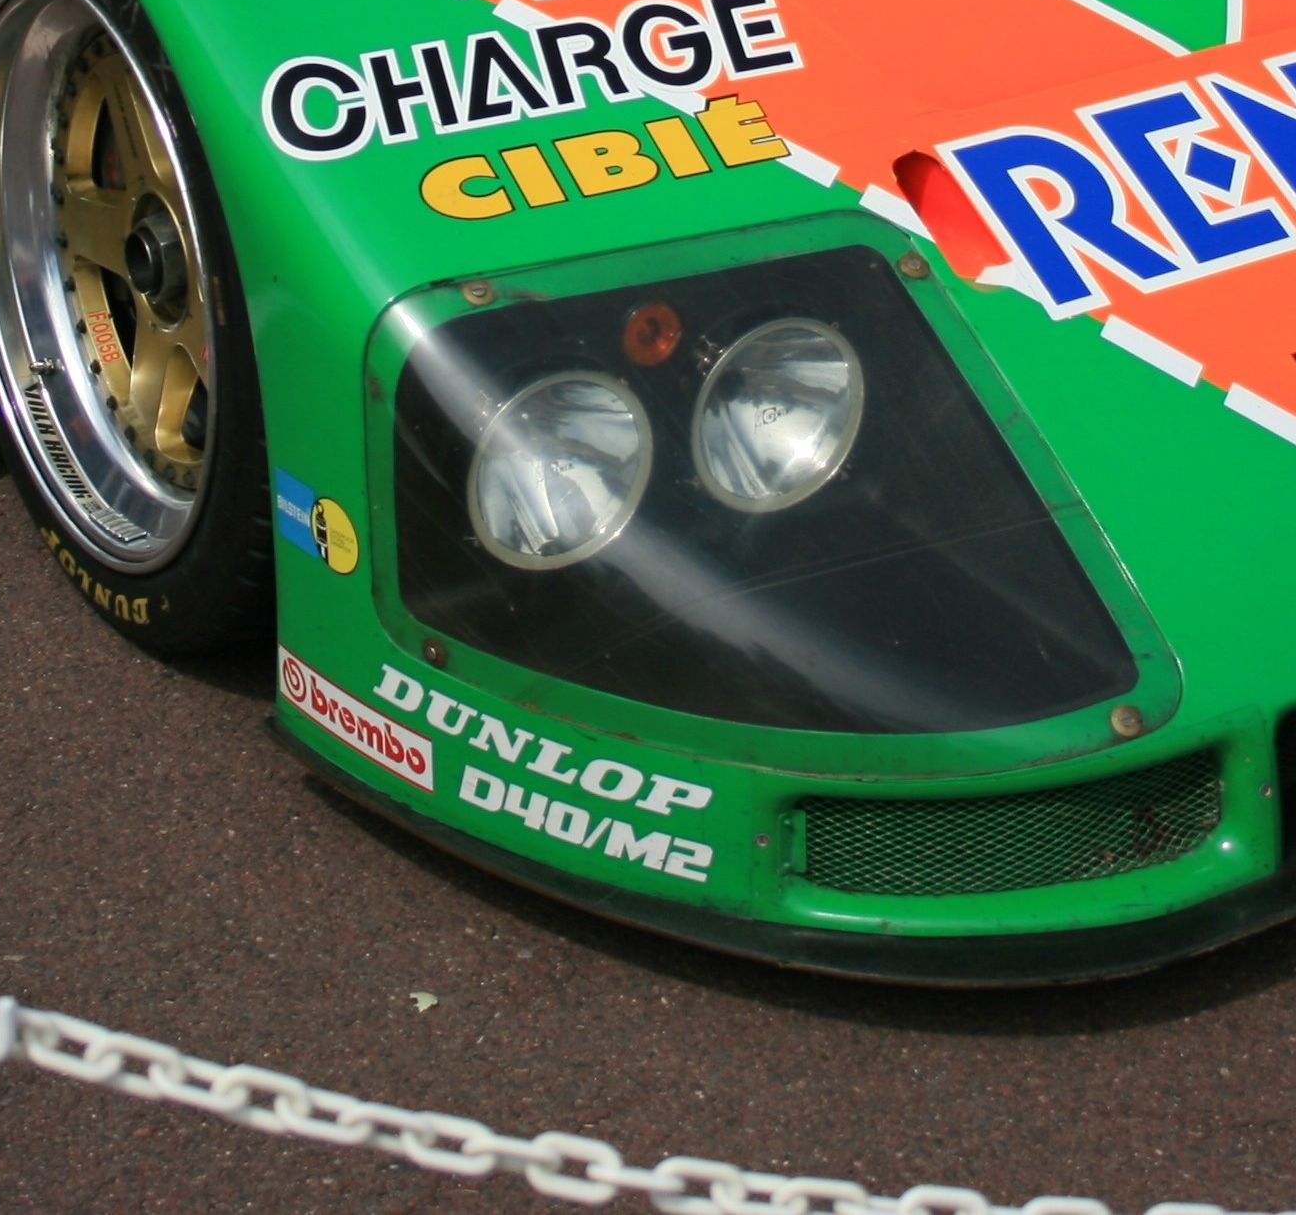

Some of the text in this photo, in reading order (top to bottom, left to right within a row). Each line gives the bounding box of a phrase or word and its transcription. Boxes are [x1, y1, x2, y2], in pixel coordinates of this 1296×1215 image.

[419, 93, 792, 221] CIBIÉ
[88, 310, 121, 364] F005B
[311, 674, 427, 775] brembo
[373, 663, 714, 816] DUNLOP
[459, 764, 714, 884] D40/M2
